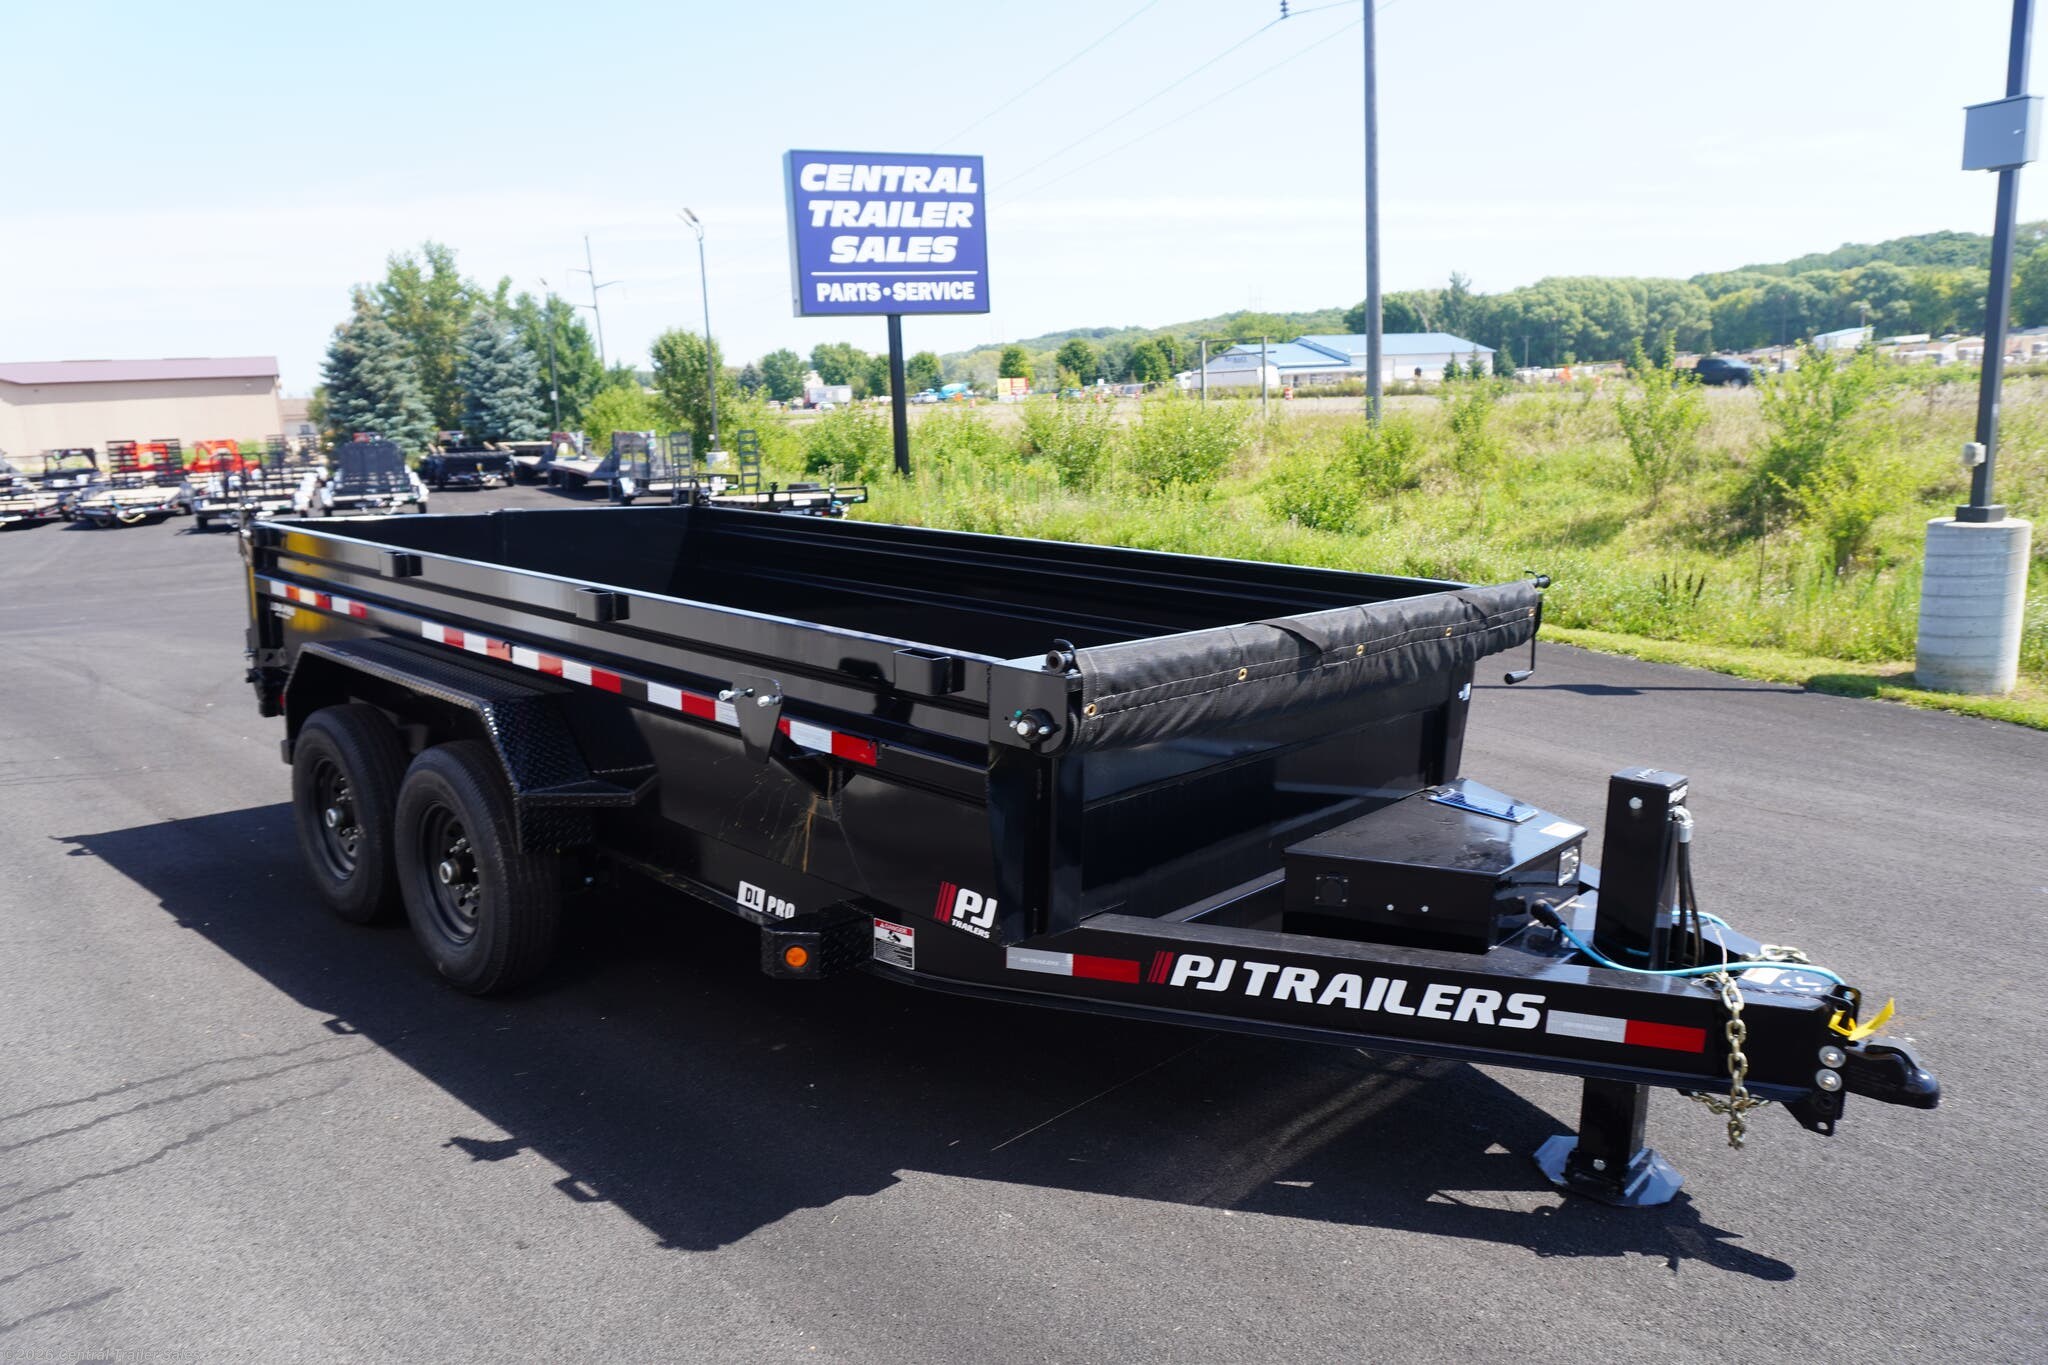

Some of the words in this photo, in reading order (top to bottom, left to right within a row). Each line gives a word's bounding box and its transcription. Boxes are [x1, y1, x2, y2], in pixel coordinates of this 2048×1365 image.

[800, 163, 978, 194] CENTRAL
[808, 200, 974, 228] TRAILER
[829, 235, 959, 264] SALES
[816, 282, 881, 302] PARTS
[892, 281, 976, 301] SERVICE
[766, 895, 795, 920] PRO
[953, 888, 998, 929] PJ
[951, 918, 991, 939] TRAILERS
[1242, 961, 1546, 1030] TRAILERS
